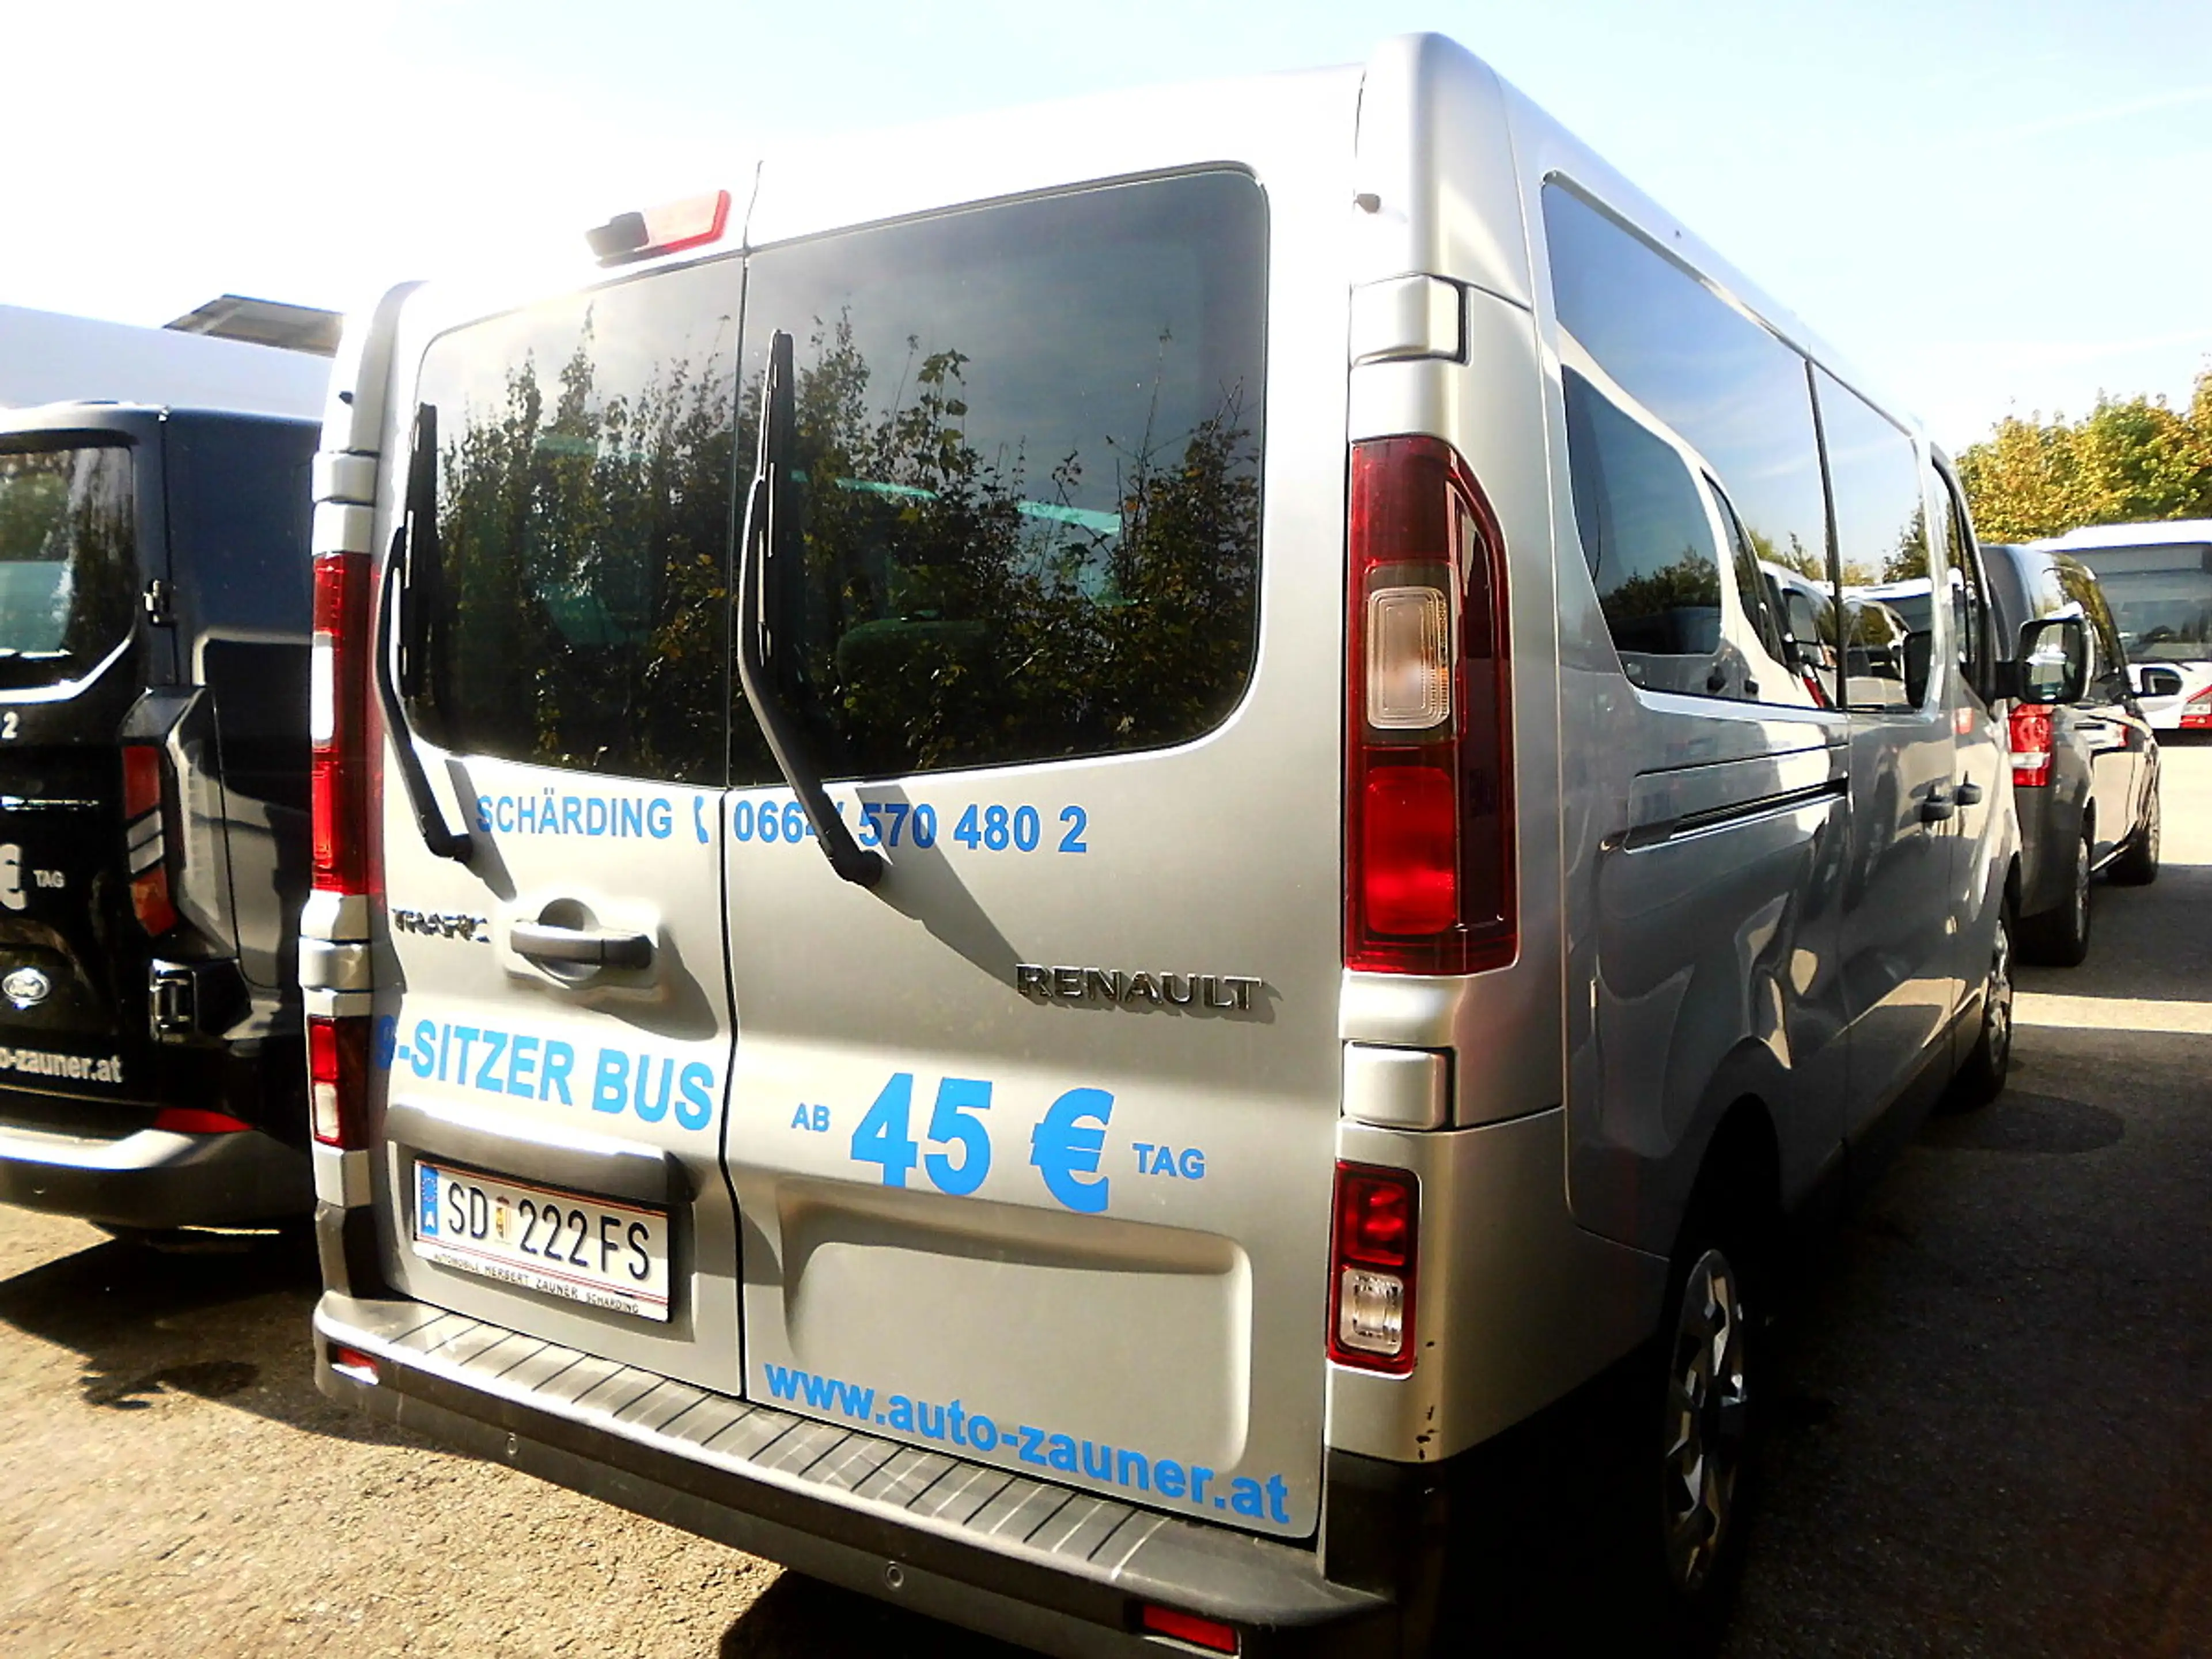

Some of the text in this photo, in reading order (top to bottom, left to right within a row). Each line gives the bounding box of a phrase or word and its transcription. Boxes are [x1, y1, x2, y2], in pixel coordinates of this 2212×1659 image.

[2, 711, 18, 738] 2
[476, 788, 1088, 853] SCHÄRDING 066 570 480 2
[33, 870, 65, 888] TAG
[1016, 964, 1263, 1010] RENAULT
[592, 1047, 715, 1131] BUS
[791, 1072, 1206, 1214] AB 45 € TAG
[448, 1181, 487, 1239] SD
[764, 1362, 1290, 1525] www.auto-zauner.at
